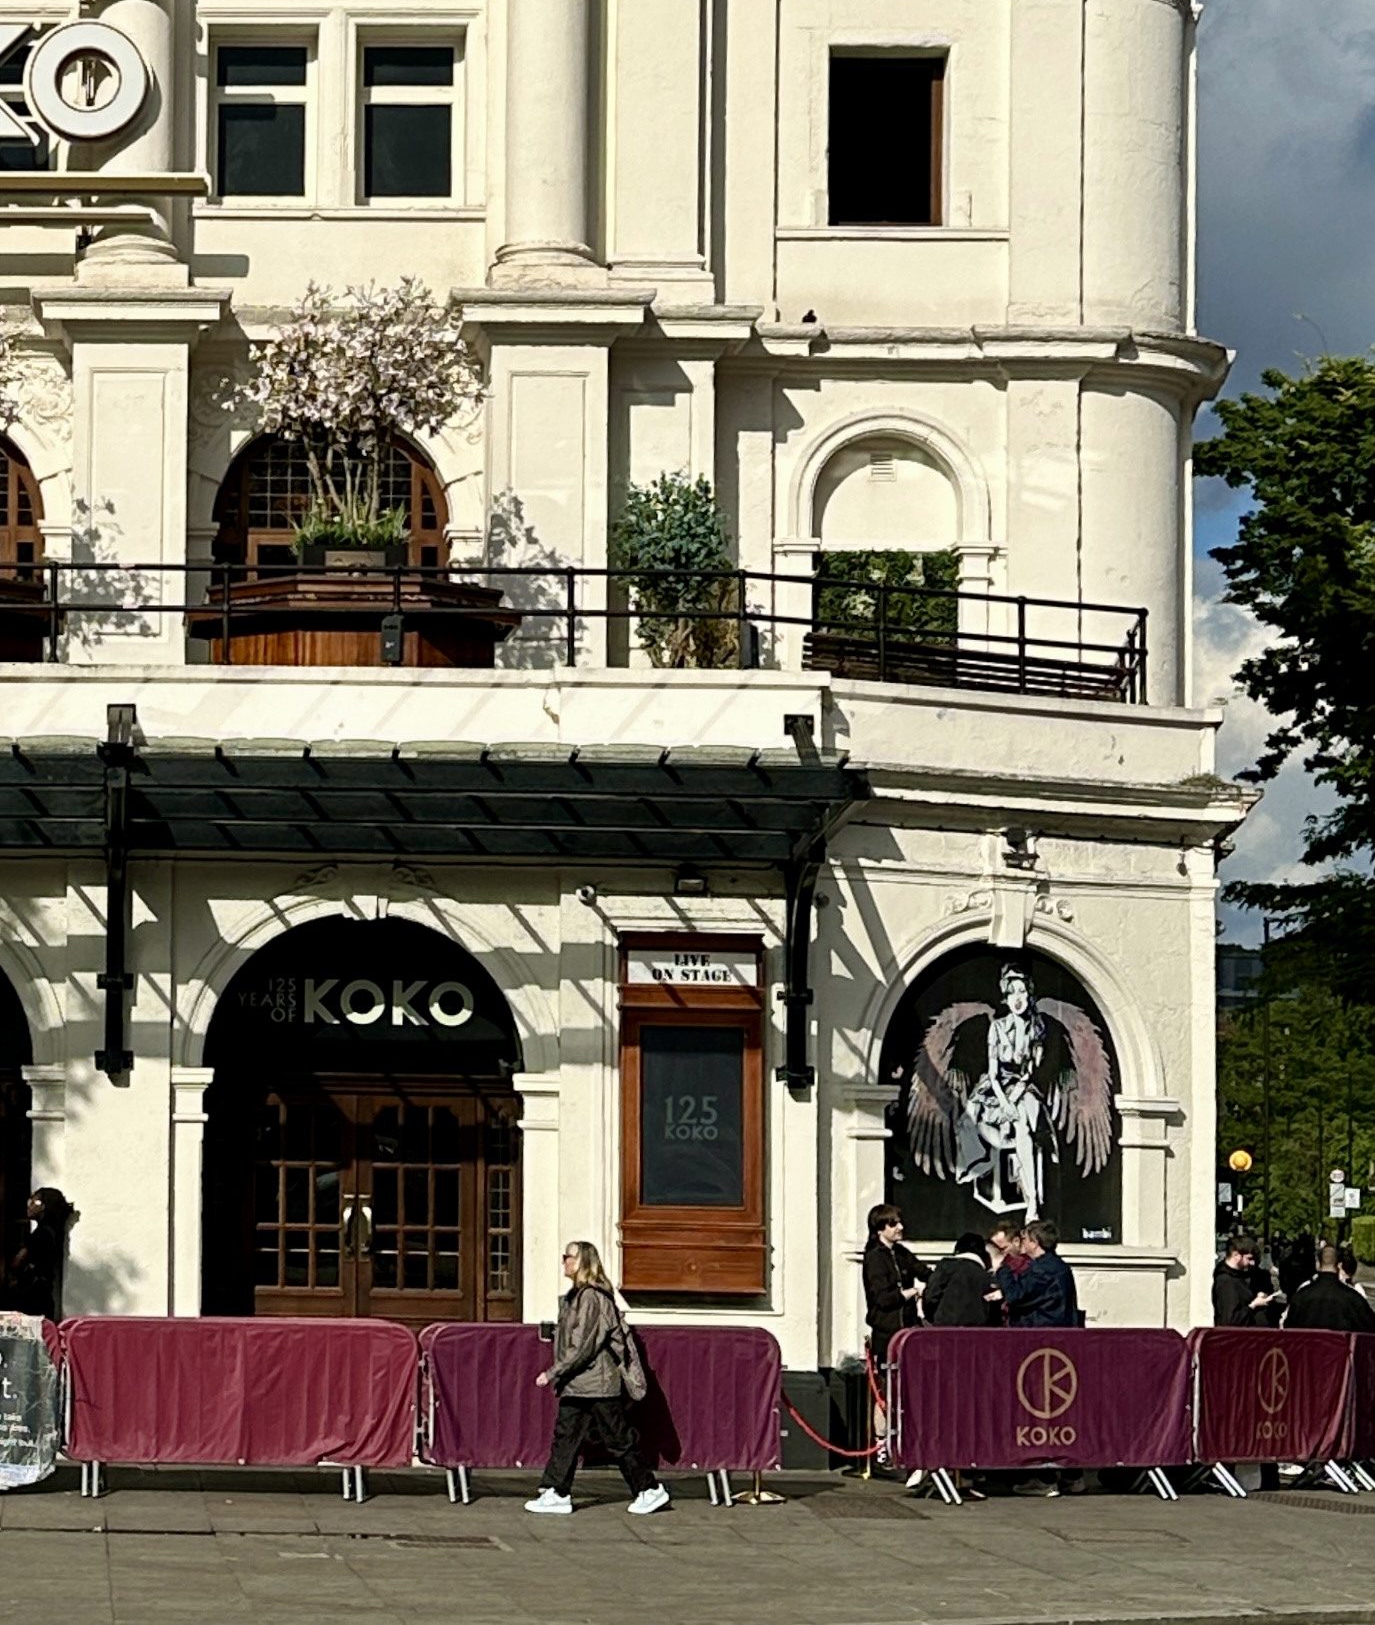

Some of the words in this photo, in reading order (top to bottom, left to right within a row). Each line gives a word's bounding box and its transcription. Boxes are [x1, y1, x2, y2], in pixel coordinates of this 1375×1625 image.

[674, 953, 711, 967] LIVE
[651, 968, 673, 981] ON
[680, 968, 733, 983] STAGE
[267, 977, 297, 992] 125
[237, 991, 297, 1007] YEARS
[304, 978, 475, 1027] KOKO
[269, 1007, 297, 1023] OF
[664, 1094, 719, 1124] 125
[665, 1125, 718, 1141] KOKO
[1016, 1426, 1077, 1446] KOKO
